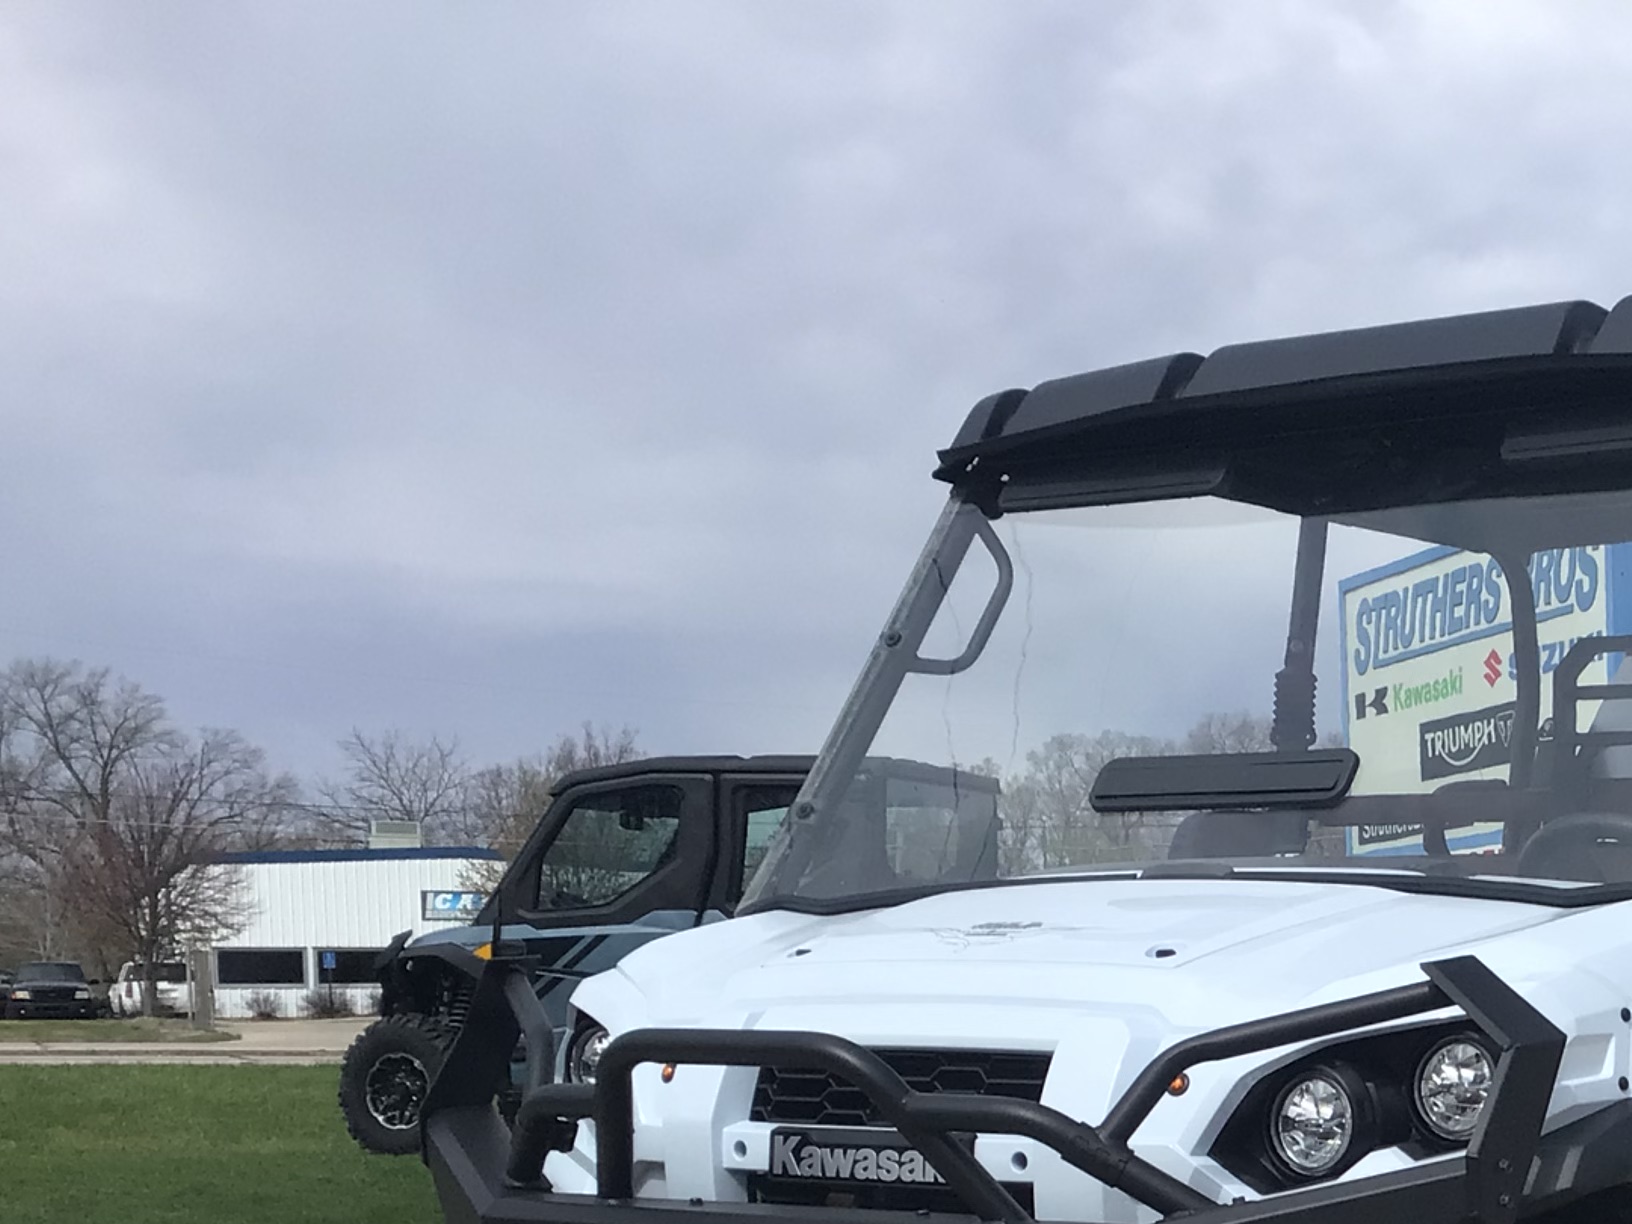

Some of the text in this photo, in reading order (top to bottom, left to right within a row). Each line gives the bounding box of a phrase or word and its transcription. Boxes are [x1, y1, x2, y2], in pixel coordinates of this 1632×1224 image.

[1354, 557, 1503, 676] STRUTHERS
[1527, 545, 1598, 613] ROS
[1393, 667, 1463, 712] Kawasaki
[1424, 718, 1497, 766] TRIUMPH
[773, 1135, 947, 1183] Kawasa
